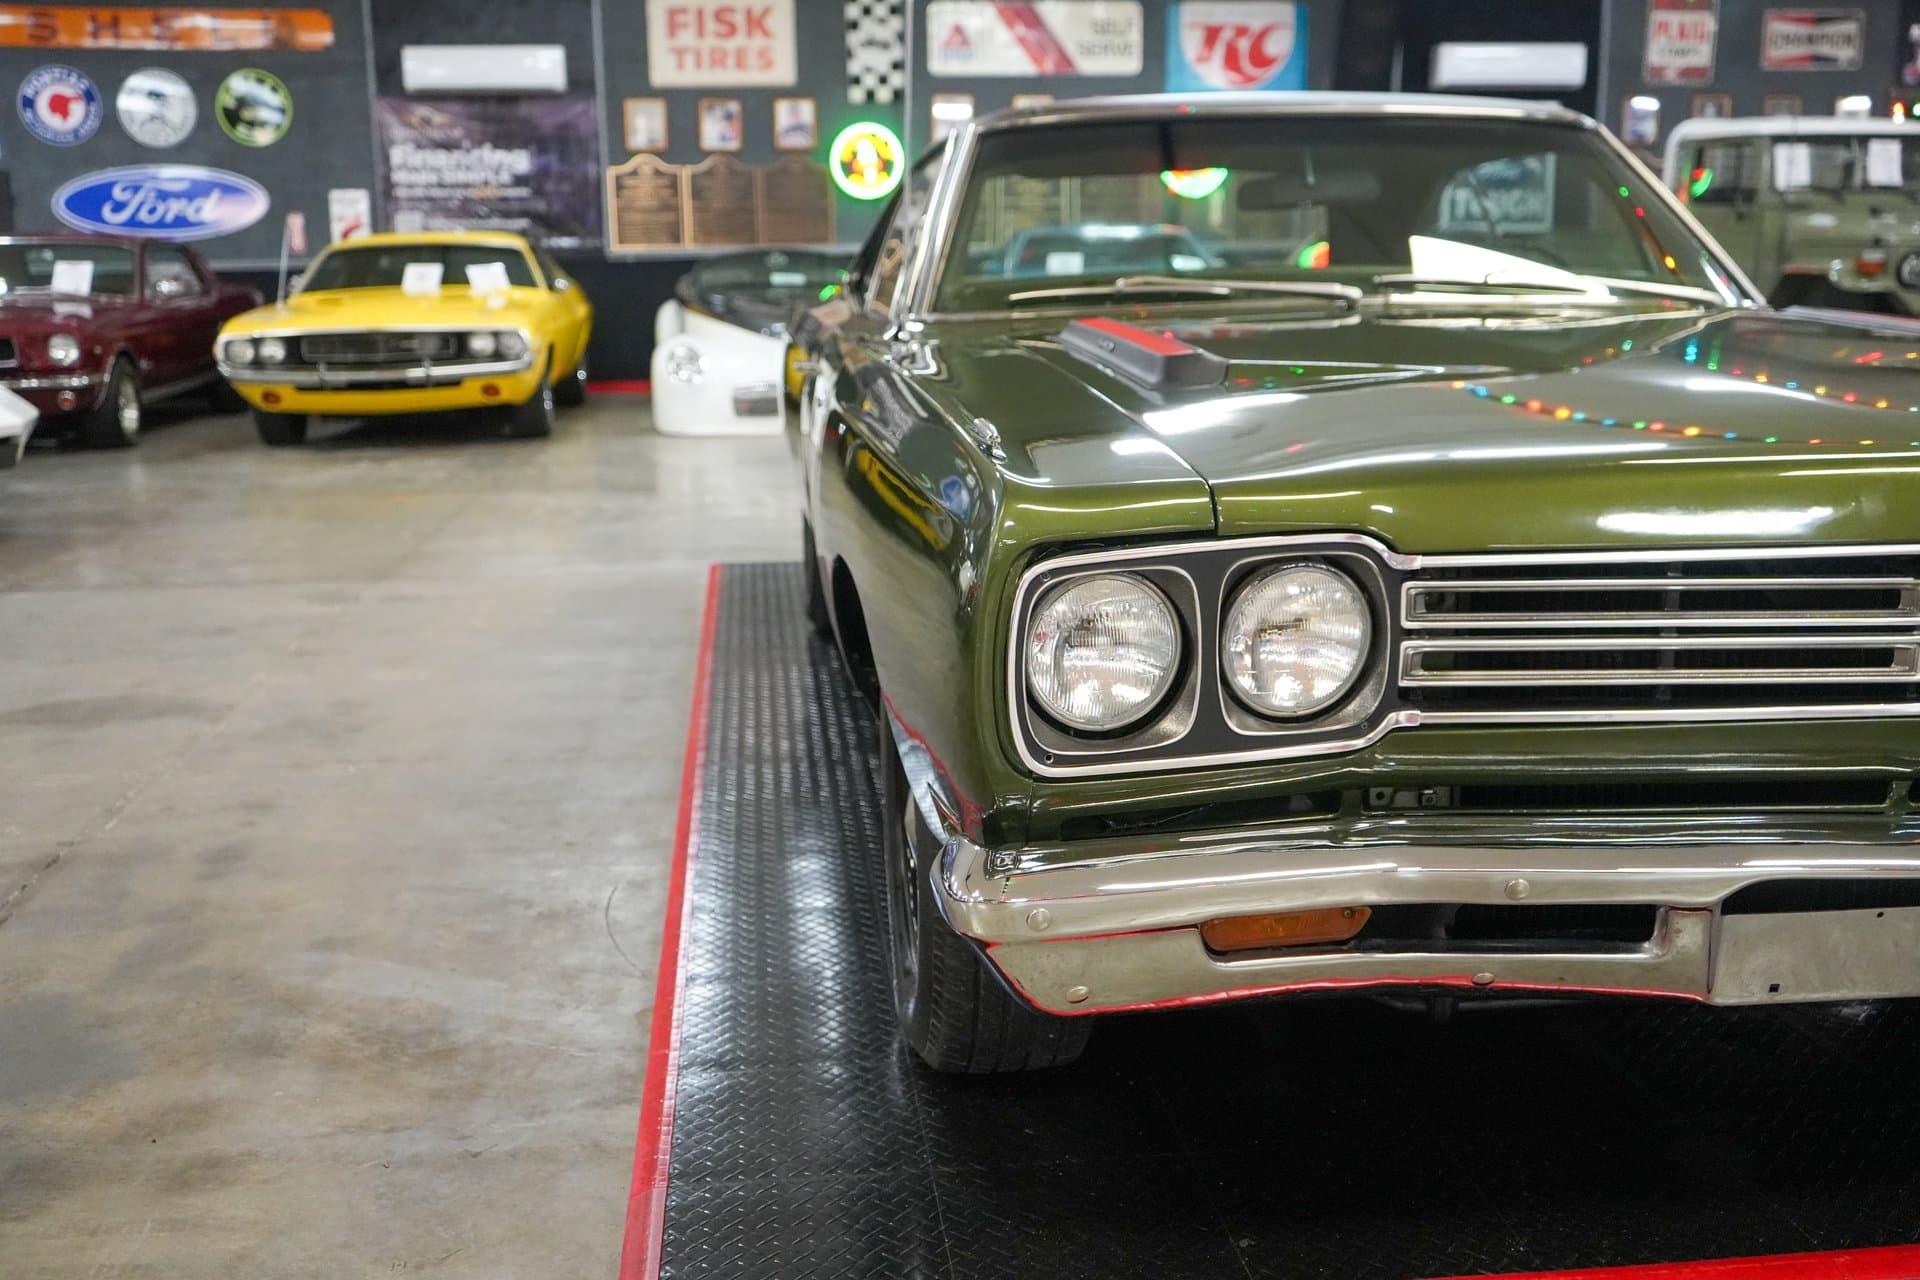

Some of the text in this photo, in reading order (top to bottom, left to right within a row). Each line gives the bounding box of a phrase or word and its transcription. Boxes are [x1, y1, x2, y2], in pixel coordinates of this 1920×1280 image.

[664, 6, 774, 39] FISK
[1186, 21, 1290, 87] RC
[1772, 31, 1856, 49] CHAMPION
[668, 46, 774, 71] TIRES
[390, 140, 530, 175] Financing
[101, 178, 221, 225] Ford
